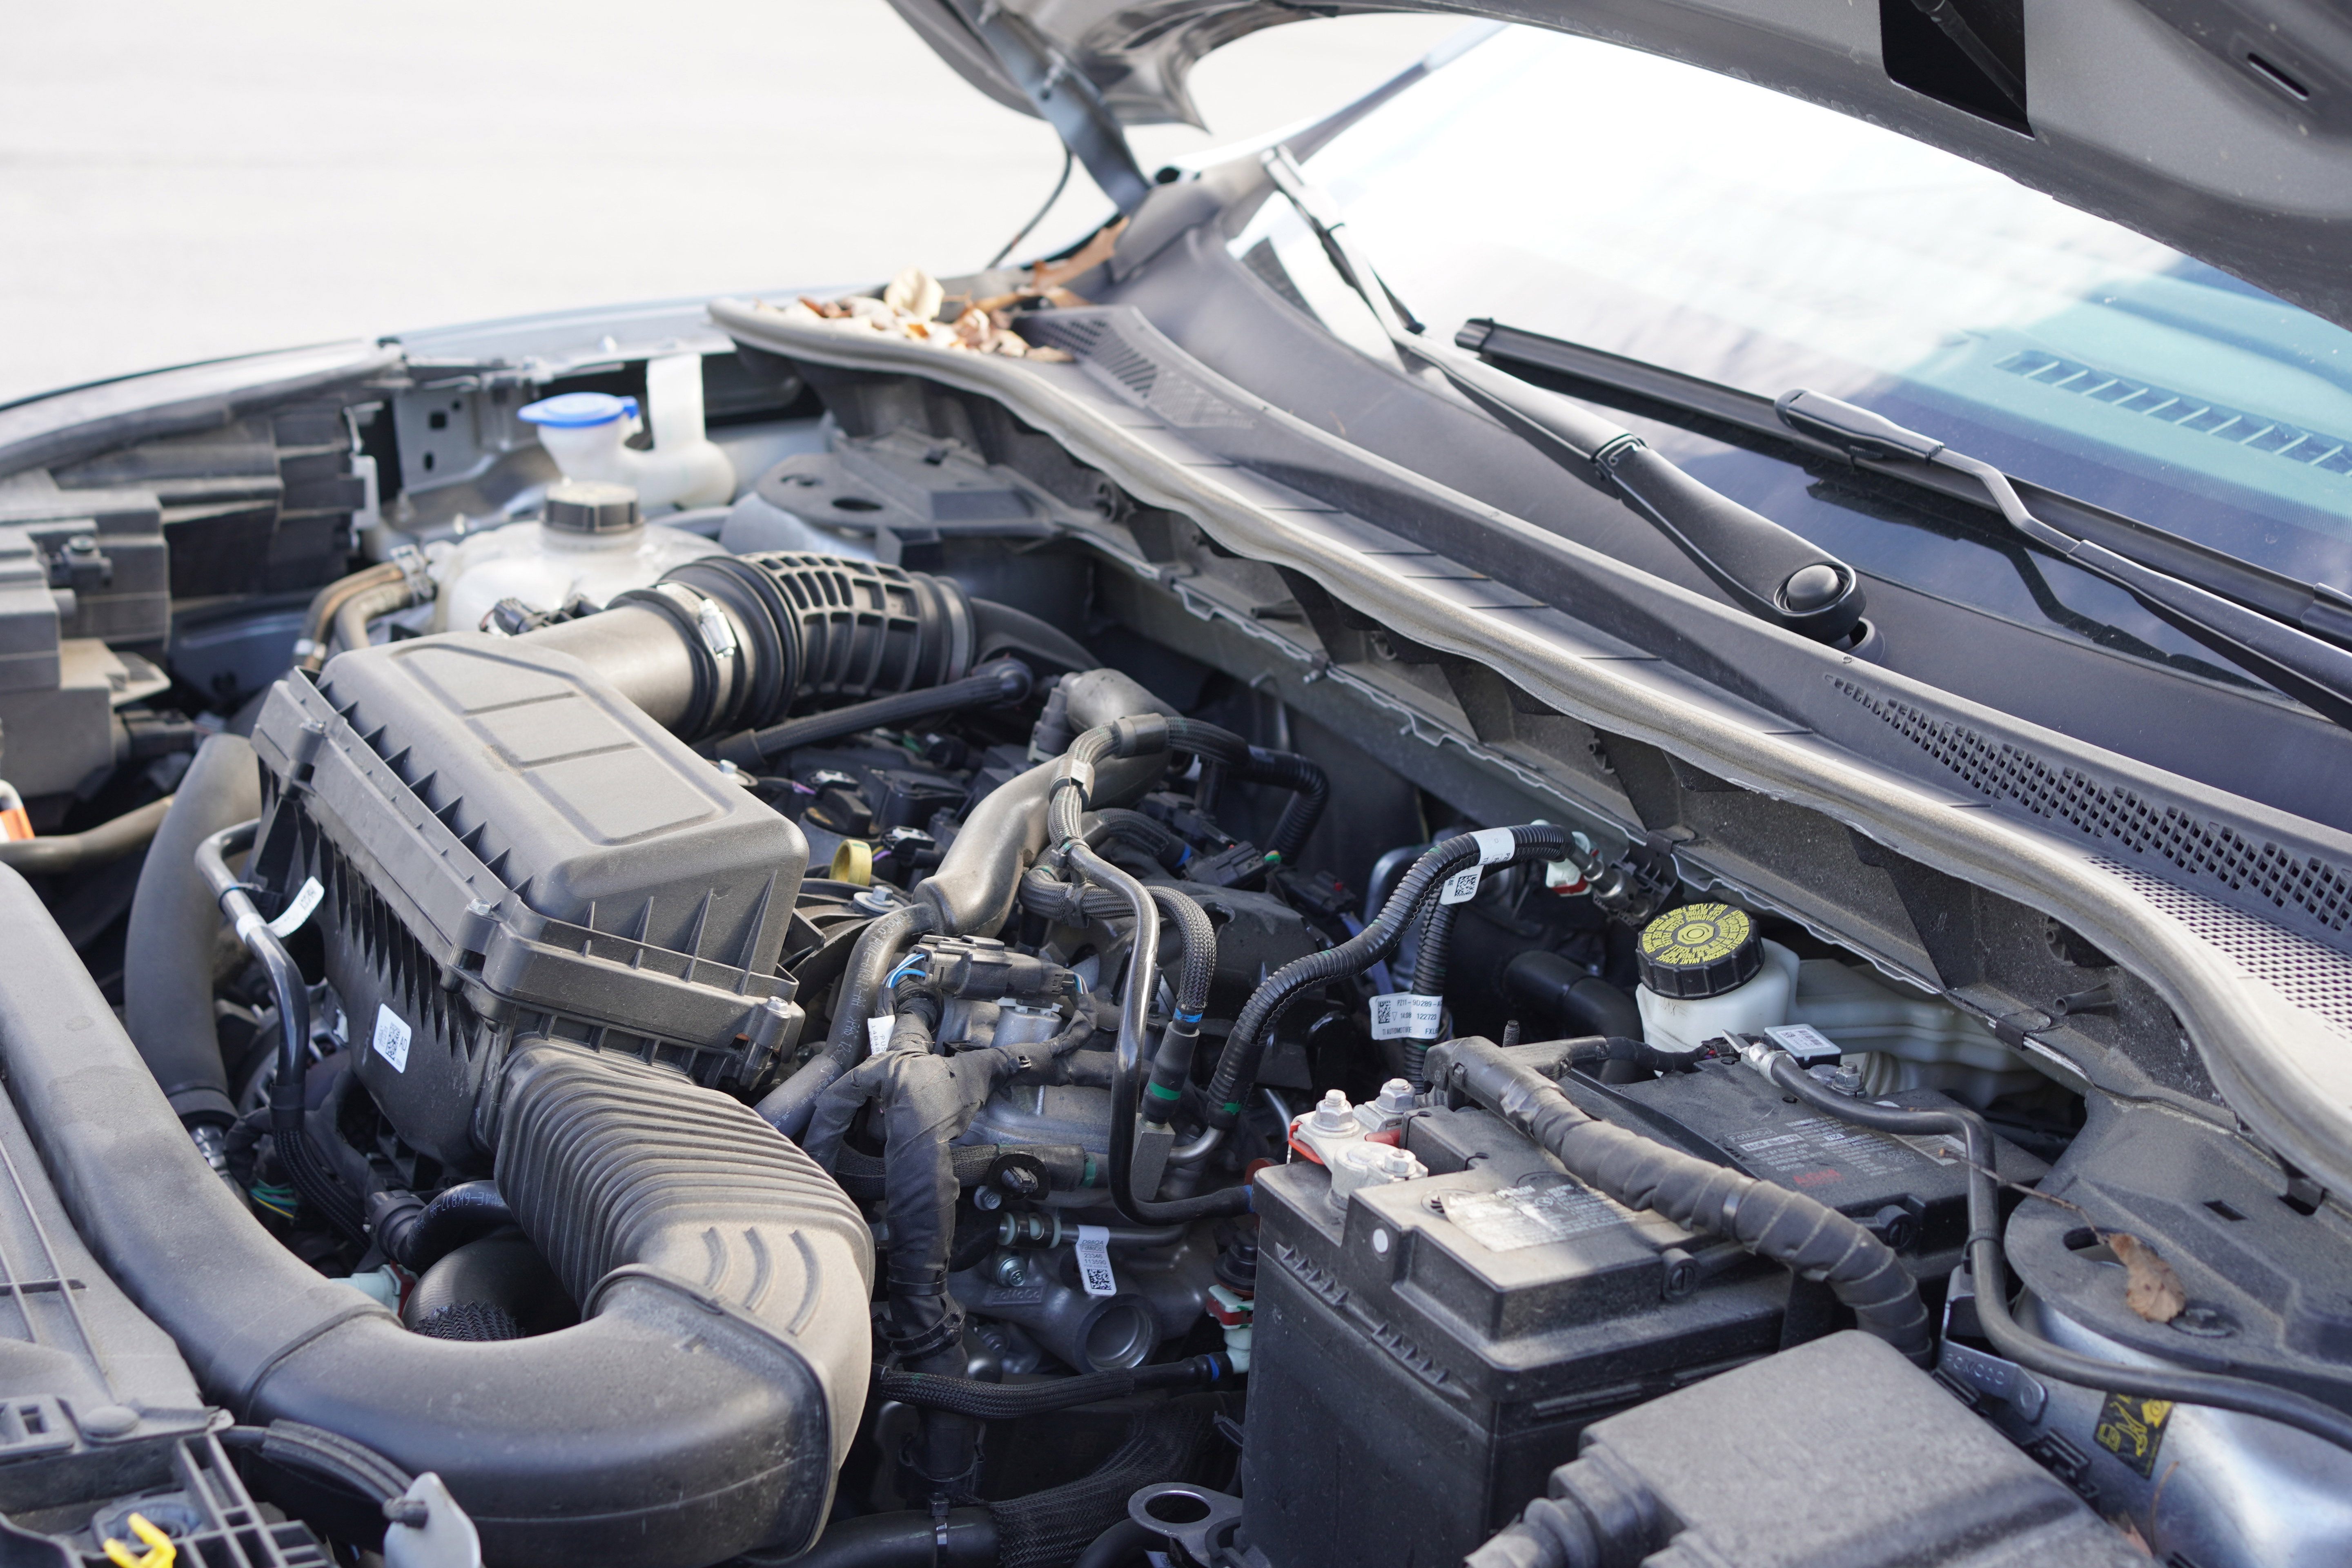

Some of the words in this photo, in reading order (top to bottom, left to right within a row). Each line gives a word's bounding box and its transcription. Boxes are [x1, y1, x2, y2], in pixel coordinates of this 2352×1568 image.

[1668, 907, 1687, 917] FROM
[1683, 908, 1709, 917] BEFORE
[1645, 918, 1664, 932] SEALED
[1655, 913, 1683, 931] REMOVING
[1665, 919, 1685, 931] CLEAN
[1642, 933, 1655, 953] CONTAINER
[1693, 944, 1711, 953] BIDON
[1702, 948, 1730, 961] BOUCHON
[1729, 1129, 1773, 1141] FoMoCo
